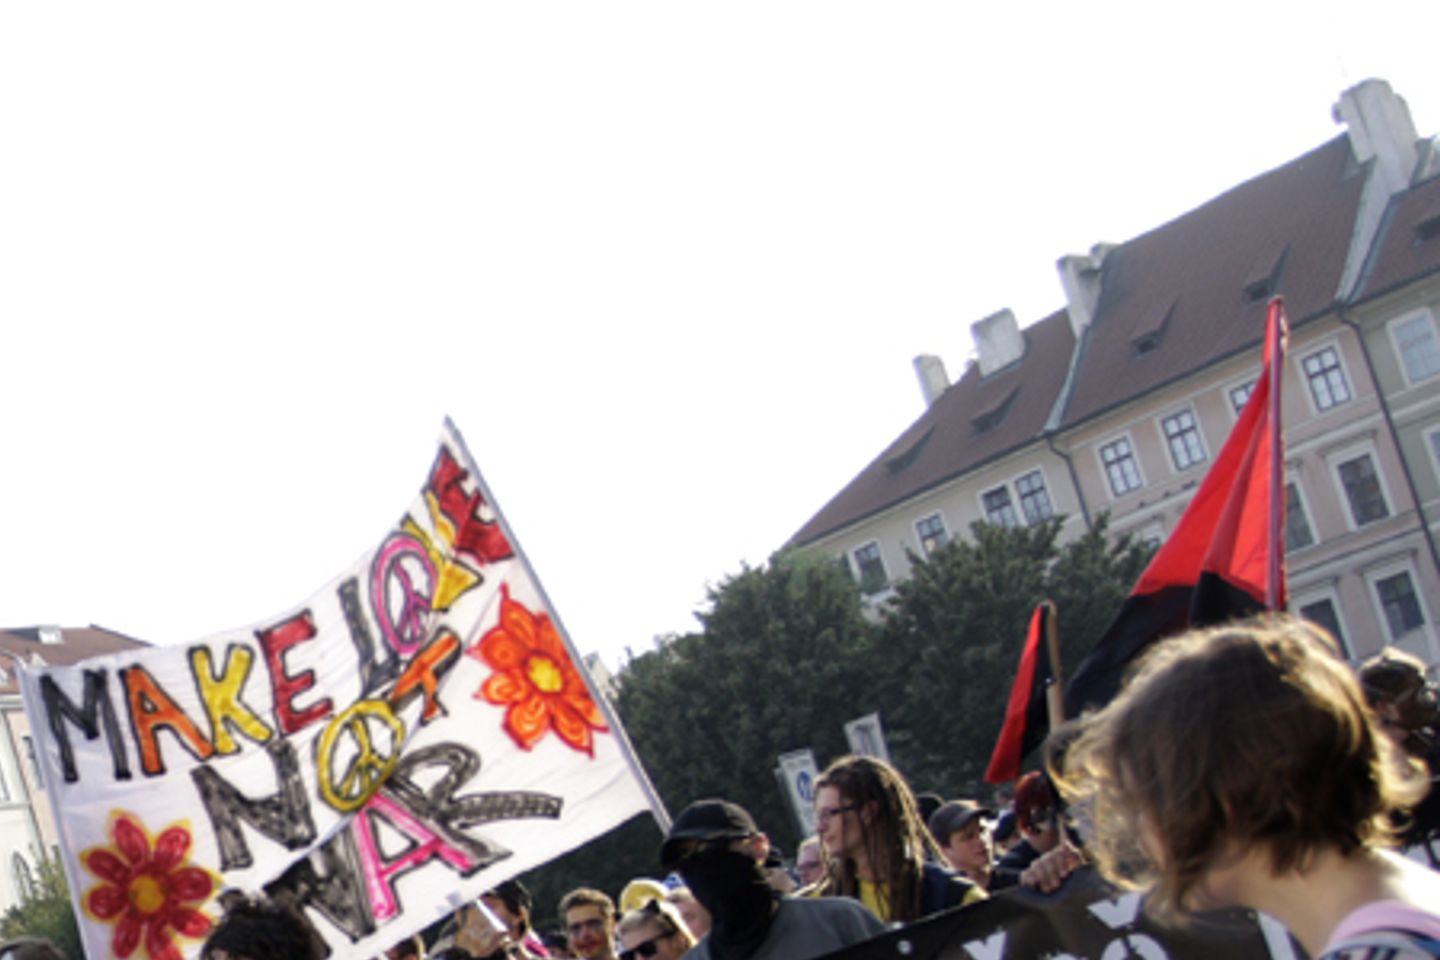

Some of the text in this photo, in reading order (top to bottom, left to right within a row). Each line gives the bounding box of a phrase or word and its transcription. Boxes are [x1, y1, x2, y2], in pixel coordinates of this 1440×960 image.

[39, 443, 516, 783] MAKE LOVE
[191, 625, 462, 872] NOT
